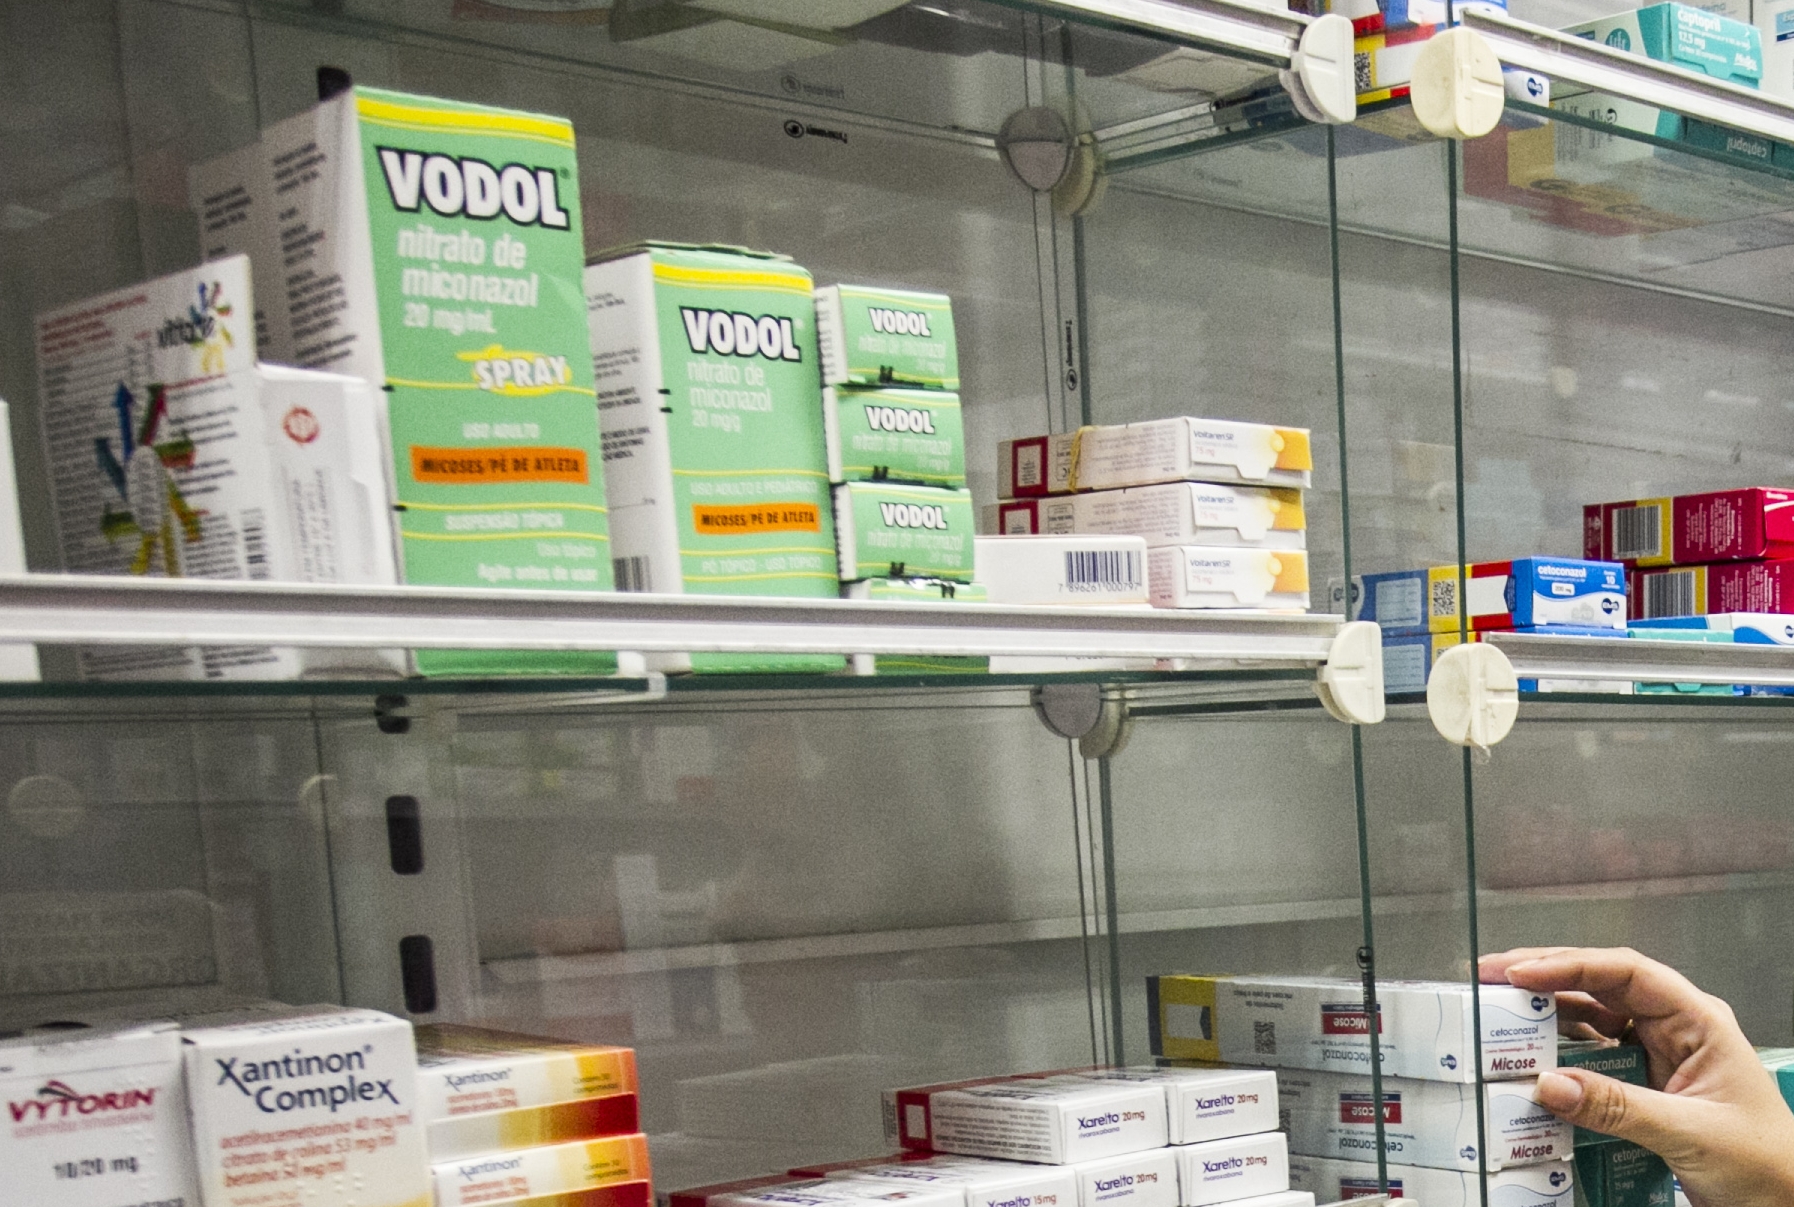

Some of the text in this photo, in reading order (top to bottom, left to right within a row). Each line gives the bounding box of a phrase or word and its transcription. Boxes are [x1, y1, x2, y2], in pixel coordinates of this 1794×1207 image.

[1677, 7, 1722, 32] captopril
[375, 144, 571, 231] VODOL
[397, 223, 527, 270] nitrato de
[402, 263, 539, 308] miconazol
[403, 302, 430, 328] 20
[868, 307, 931, 337] VODOL
[679, 305, 802, 362] VODOL
[475, 354, 568, 391] SPRAY
[687, 358, 764, 387] nitrato de
[690, 385, 772, 412] miconazol
[692, 408, 708, 427] 20
[865, 405, 935, 434] VODOL
[463, 423, 539, 439] USO ADULTO
[513, 457, 580, 472] DE ATLETA
[691, 479, 753, 496] USO ADULTO
[767, 511, 815, 525] DE ATLETA
[880, 502, 948, 530] VODOL
[914, 533, 963, 553] miconazol
[766, 557, 788, 572] USO
[1537, 564, 1587, 579] cetoconazol
[1490, 1025, 1539, 1037] cetoconazol
[216, 1048, 366, 1097] Xantinon
[1491, 1057, 1536, 1071] Micose
[444, 1068, 509, 1091] Xantinon
[9, 1083, 156, 1122] VYTORIN
[255, 1075, 400, 1114] Complex
[1195, 1094, 1235, 1111] Xarelto
[1078, 1112, 1119, 1130] Xarelto
[1078, 1126, 1120, 1139] rivaroxabana
[222, 1152, 269, 1169] citrato
[1510, 1144, 1553, 1160] Micose
[110, 1157, 139, 1175] mg
[459, 1157, 521, 1181] Xantinon
[1202, 1156, 1243, 1174] Xarelto
[1094, 1174, 1134, 1193] Xarelto
